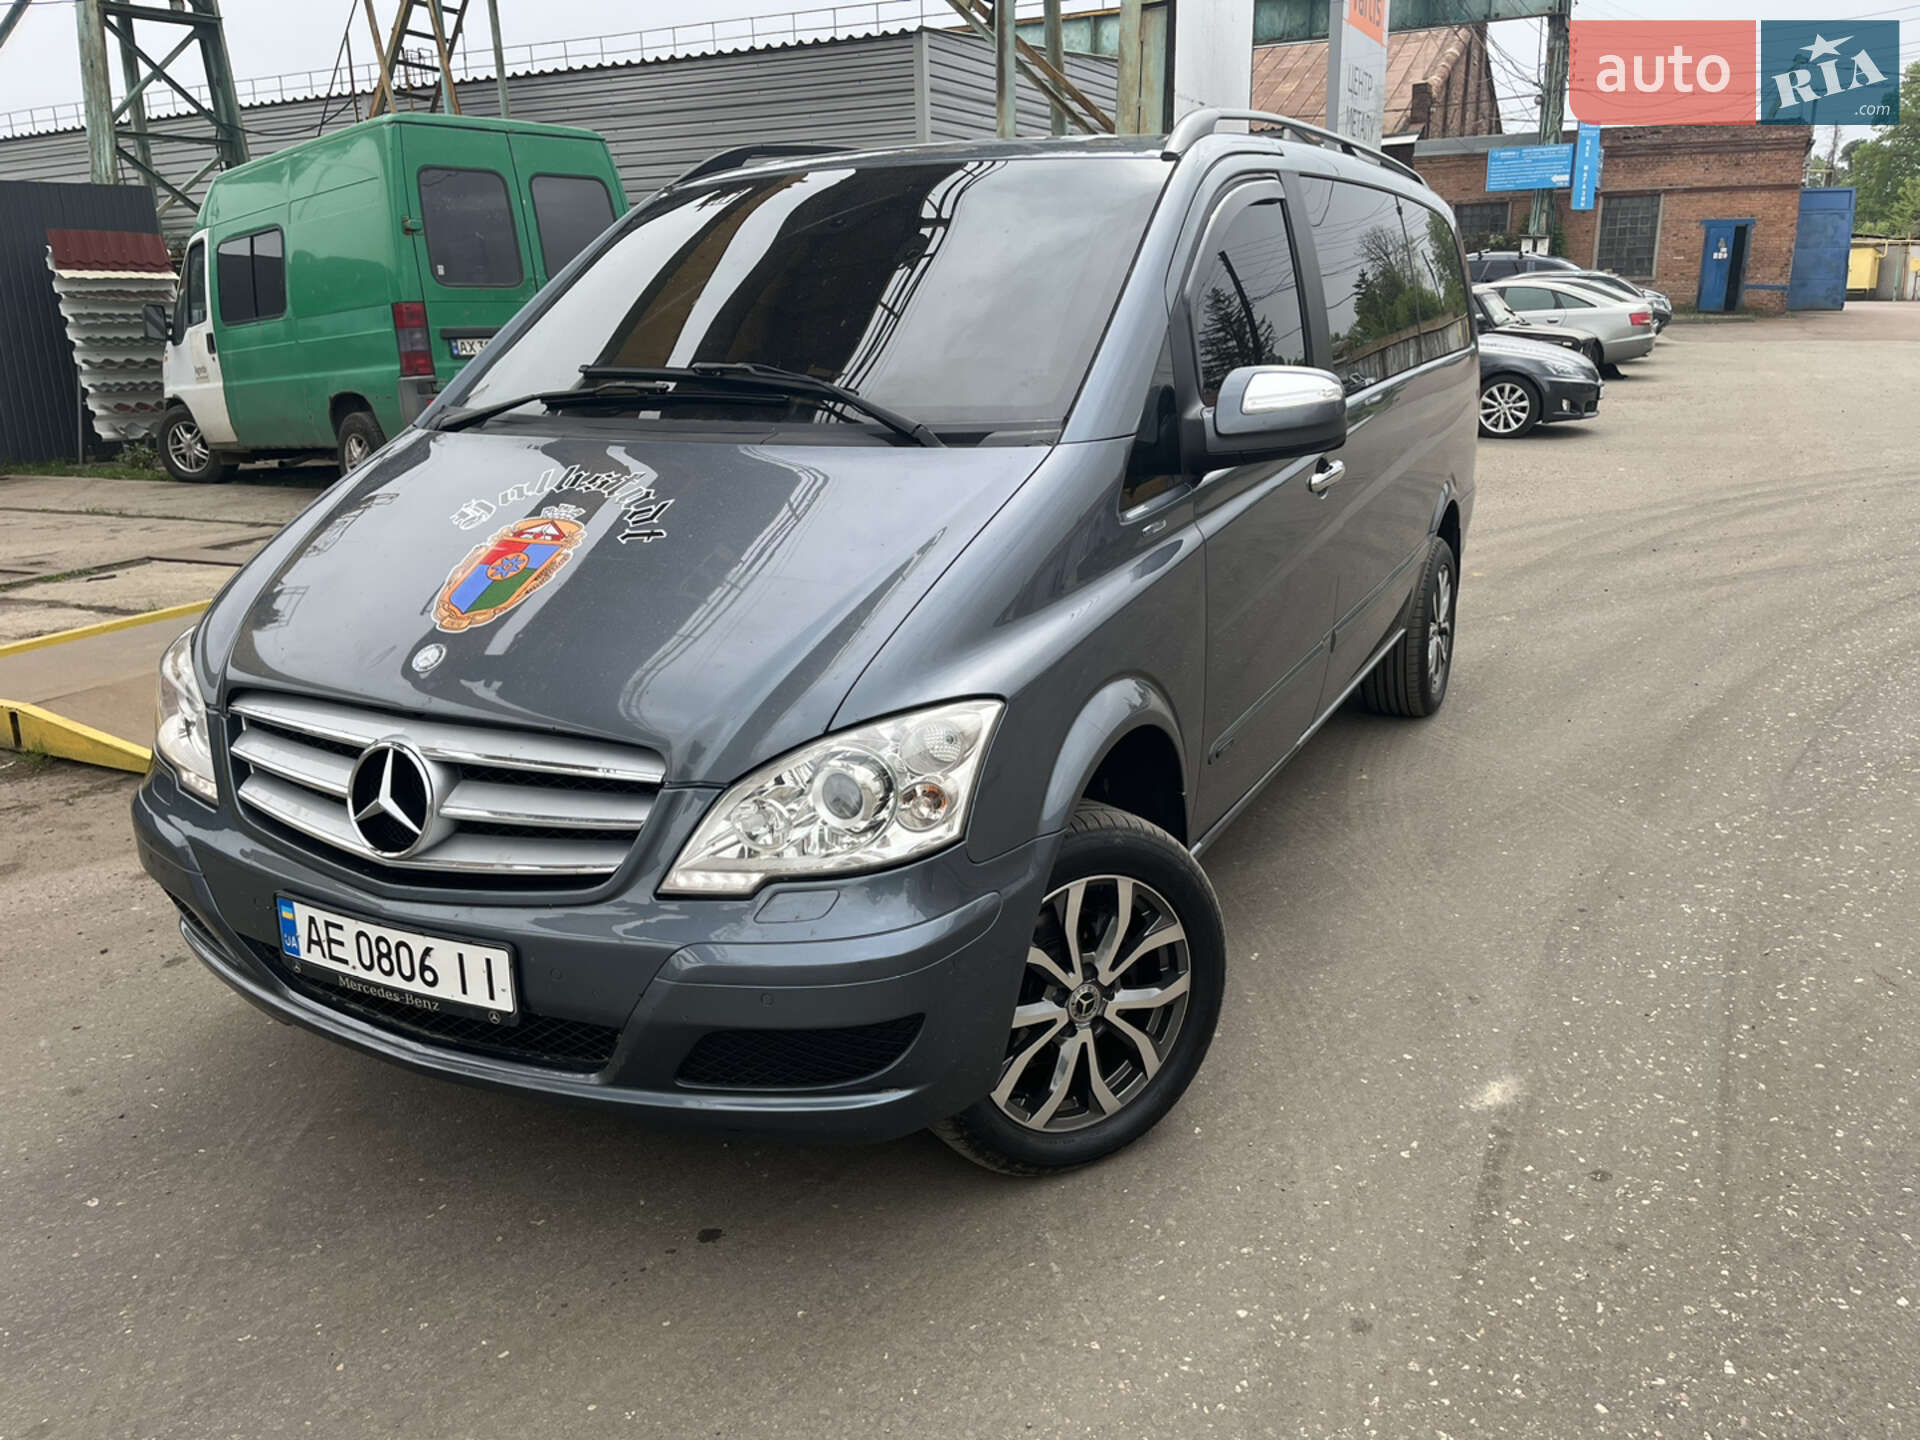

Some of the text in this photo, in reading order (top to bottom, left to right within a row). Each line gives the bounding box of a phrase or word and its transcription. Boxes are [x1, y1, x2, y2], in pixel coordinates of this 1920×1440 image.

[307, 915, 349, 966] AE
[355, 930, 439, 988] 0806
[338, 975, 440, 1012] Mercedes-Benz
